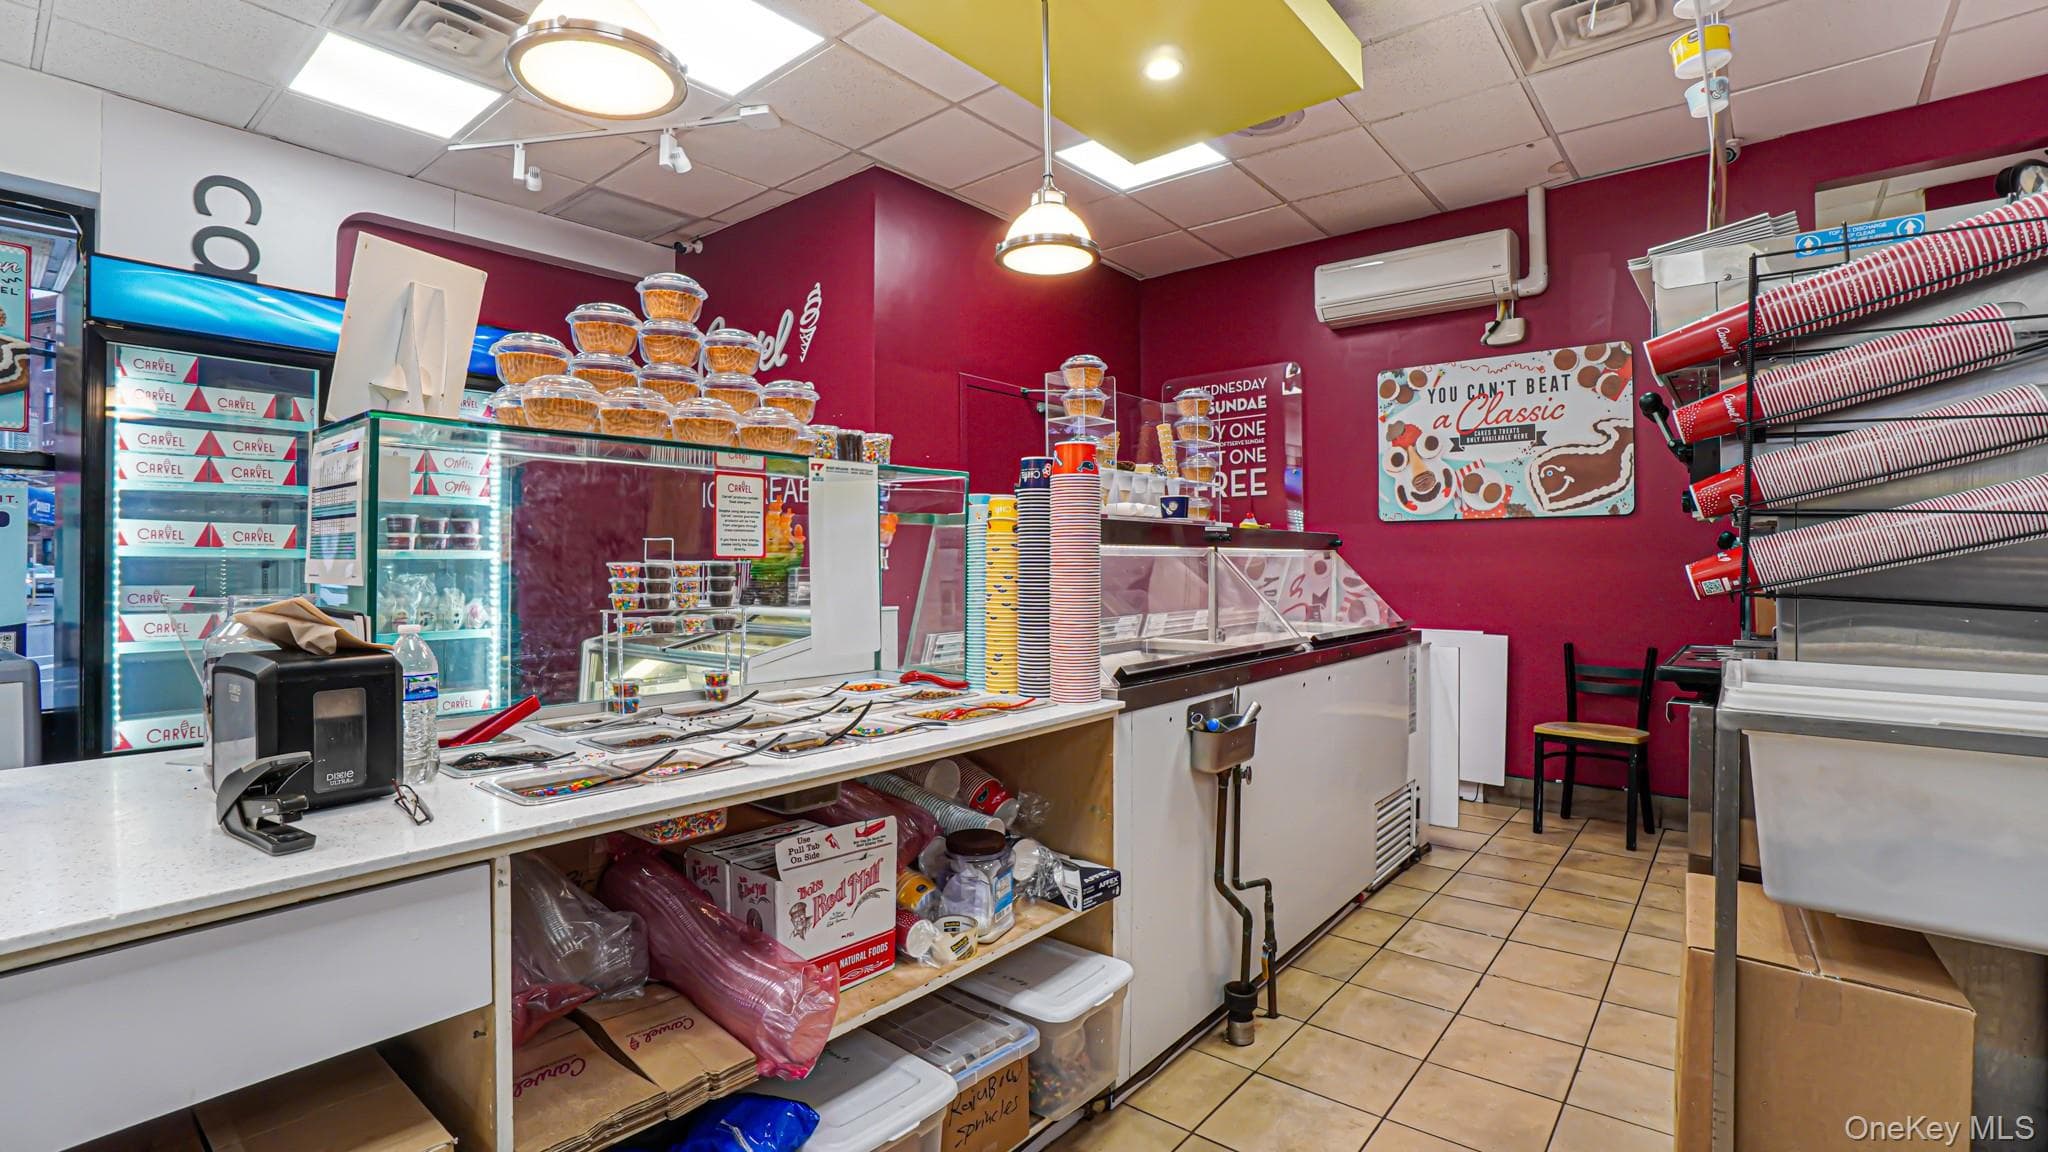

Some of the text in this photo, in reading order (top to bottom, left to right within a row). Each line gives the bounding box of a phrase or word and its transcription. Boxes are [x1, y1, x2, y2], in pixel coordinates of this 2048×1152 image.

[133, 357, 176, 373] CARVEL
[1427, 373, 1571, 404] YOU CAN'T BEAT
[217, 396, 256, 411] CARVEL
[1433, 390, 1566, 435] a Classic
[1229, 420, 1266, 439] ONE
[138, 432, 276, 453] CARVEL CARVEL
[1229, 446, 1267, 466] ONE
[136, 460, 274, 480] CARVEL CARVEL
[727, 481, 752, 494] CARVEL
[137, 527, 275, 543] CARVEL CARVEL
[143, 621, 189, 635] CARVEL
[442, 698, 473, 711] CARVEL
[147, 726, 203, 744] CARVEL
[788, 842, 820, 856] Pull Tab
[797, 835, 811, 845] Use
[790, 851, 820, 865] On Side
[797, 879, 824, 900] Bob's
[812, 858, 883, 929] Red Mill
[839, 951, 867, 969] NATURAL
[868, 942, 888, 958] FOODS
[642, 1016, 695, 1043] Carvel
